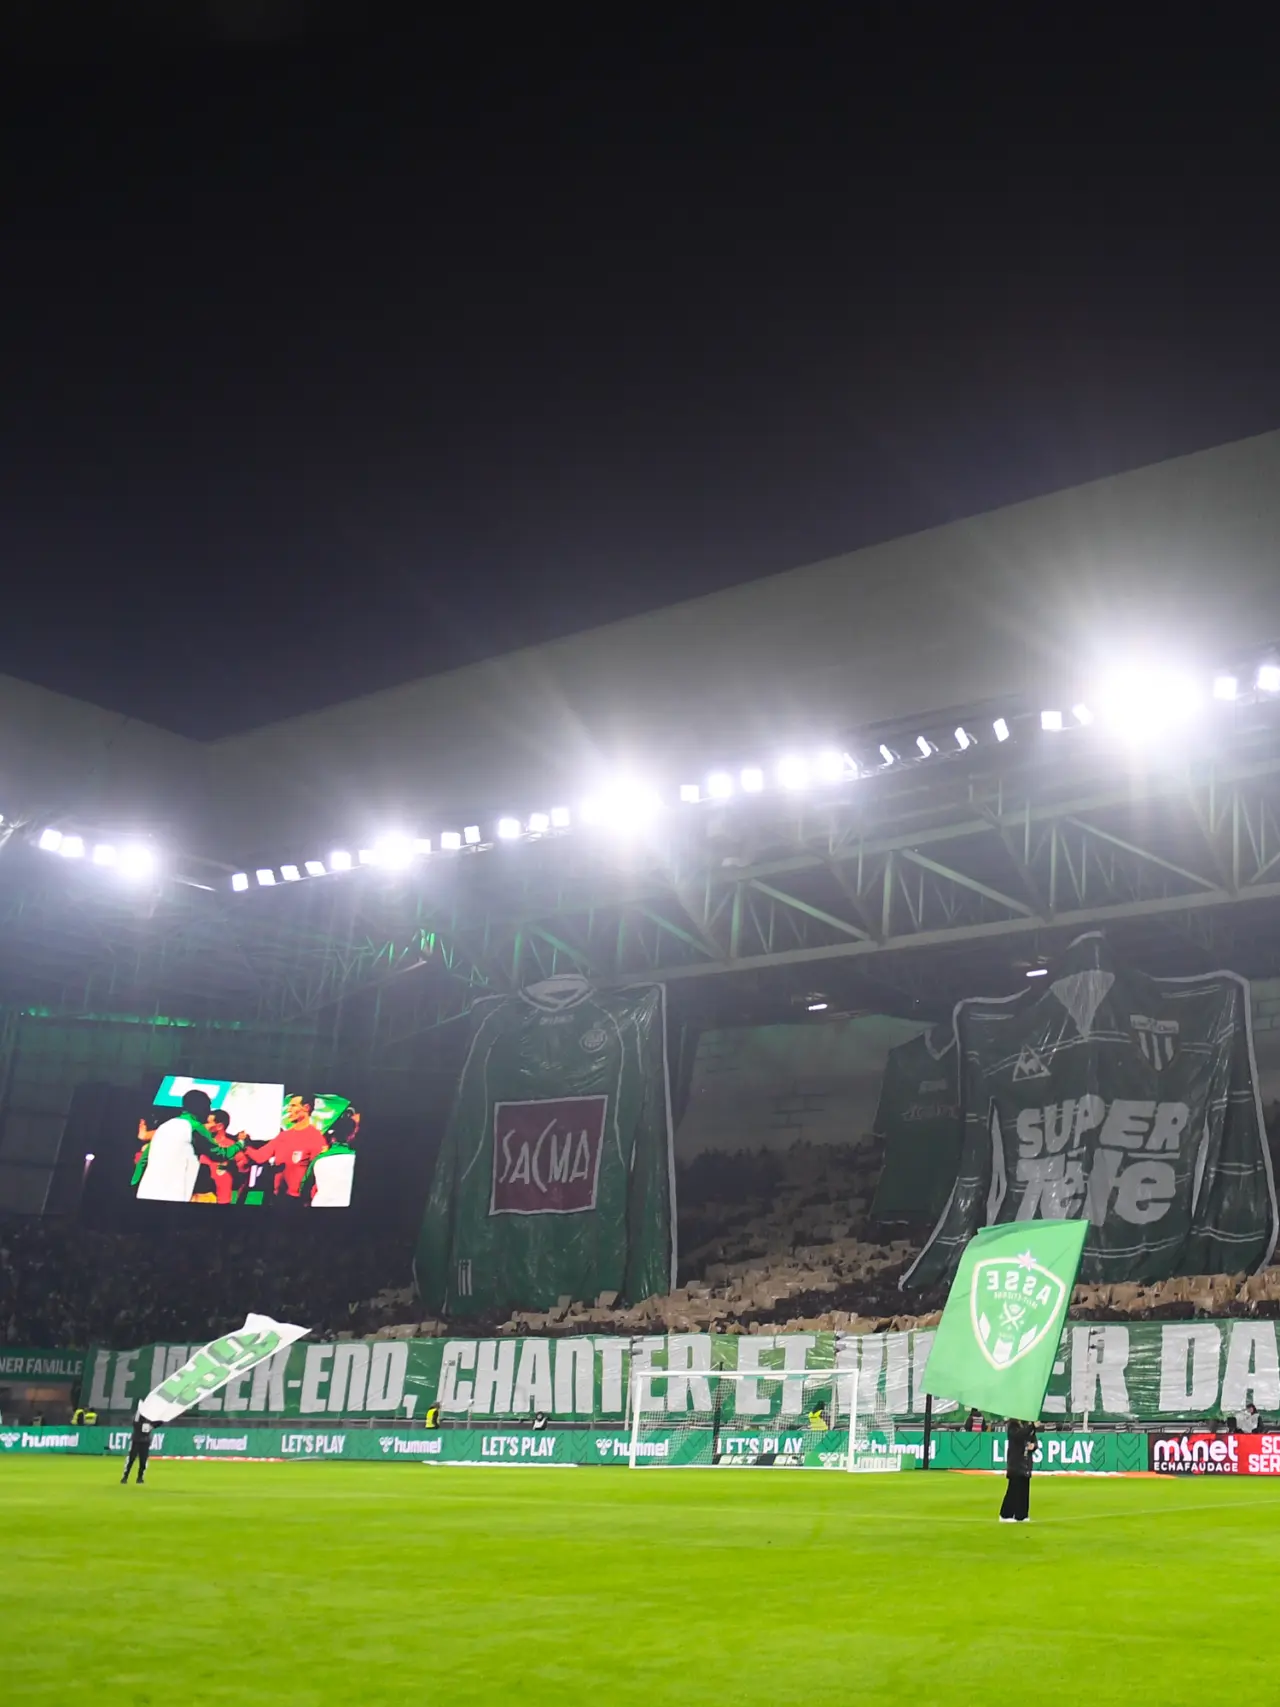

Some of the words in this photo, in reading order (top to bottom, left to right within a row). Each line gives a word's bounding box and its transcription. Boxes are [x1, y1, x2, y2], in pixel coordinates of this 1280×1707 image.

[1016, 1094, 1190, 1159] SUPER
[26, 1357, 83, 1375] FAMILLE
[88, 1349, 140, 1410] LE
[151, 1340, 418, 1418] WEK-END,
[436, 1333, 713, 1415] CHANTER
[735, 1333, 816, 1414] ET
[109, 1432, 133, 1450] LET'
[148, 1433, 165, 1450] AY
[205, 1434, 247, 1451] hummel
[281, 1434, 314, 1454] LET'S
[316, 1435, 346, 1454] PLAY
[394, 1437, 443, 1455] hummel
[481, 1436, 519, 1456] LET'S
[521, 1436, 556, 1457] PLAY
[716, 1437, 759, 1455] LET'S
[762, 1437, 803, 1455] PLAY
[871, 1439, 936, 1460] humml
[1047, 1440, 1095, 1464] PLAY
[1153, 1461, 1239, 1472] ECHAFAUDAGE
